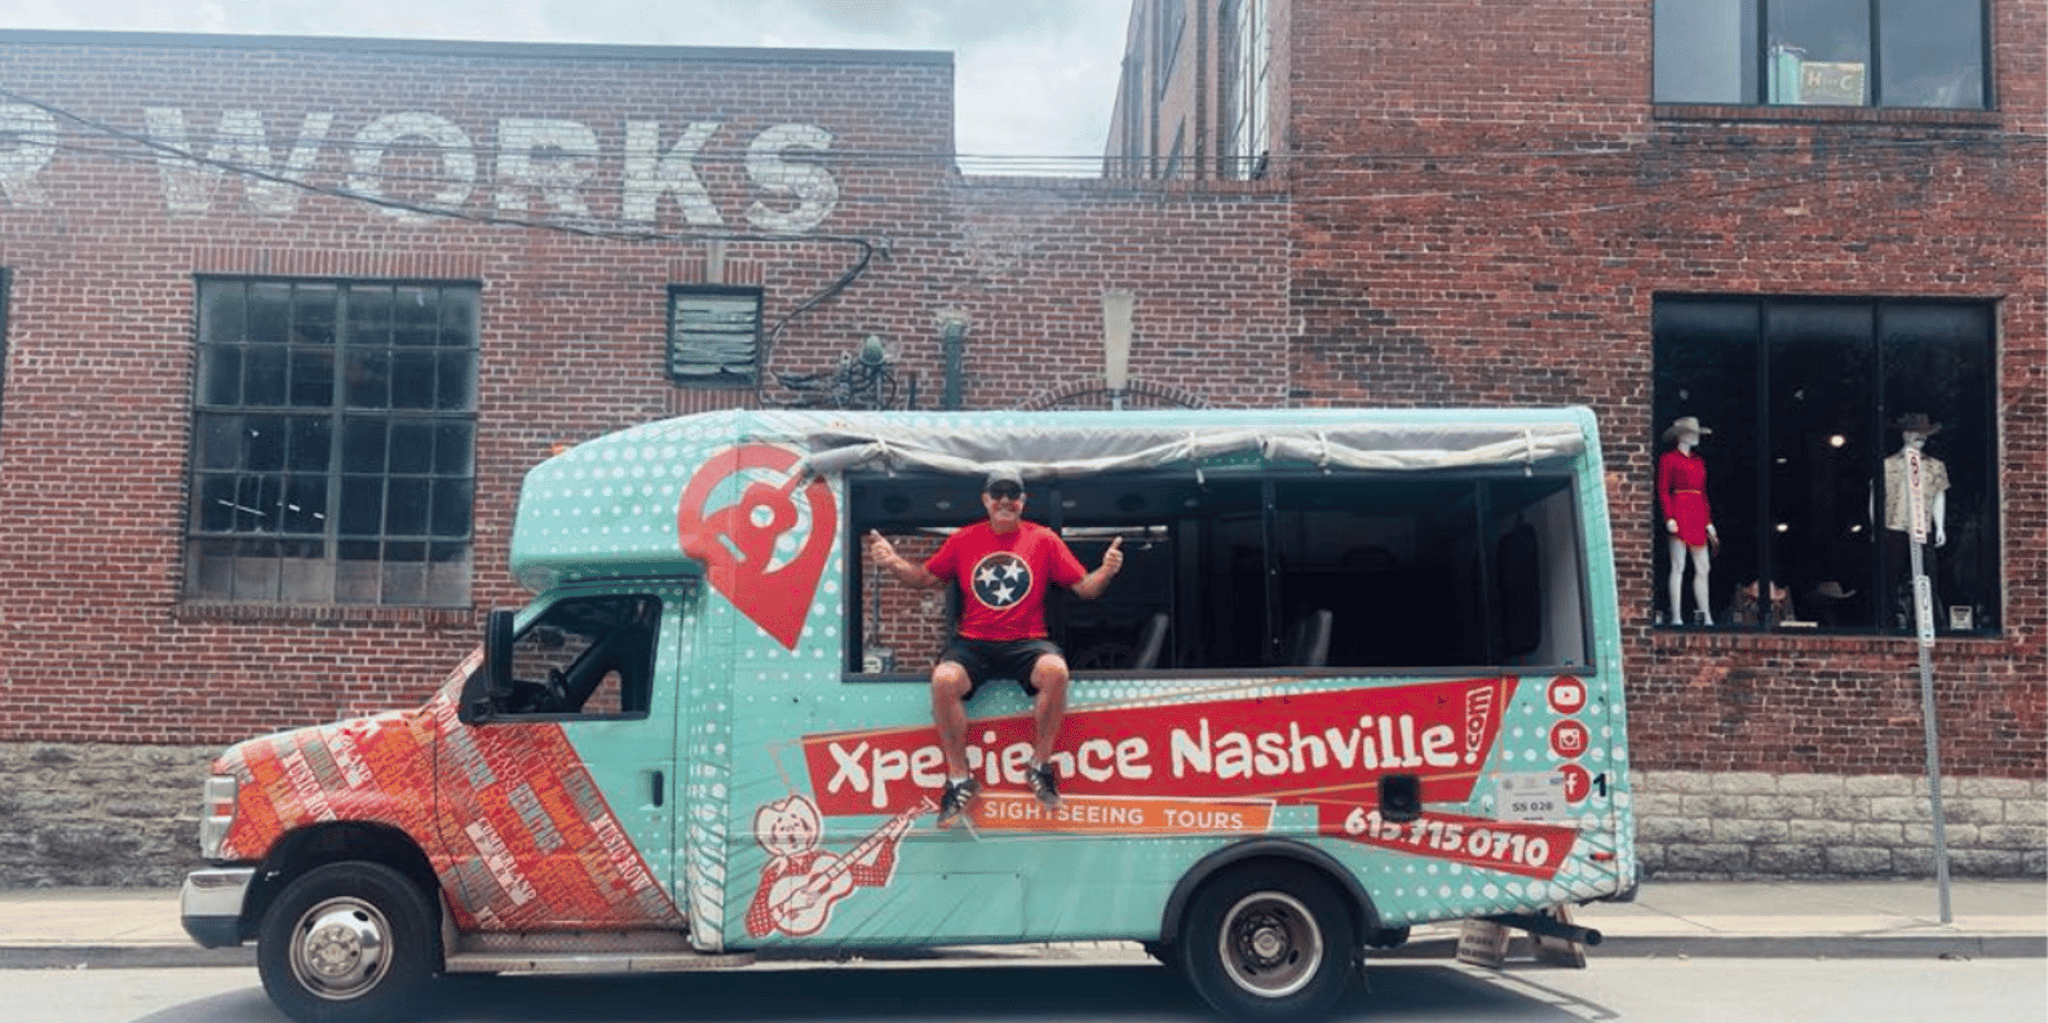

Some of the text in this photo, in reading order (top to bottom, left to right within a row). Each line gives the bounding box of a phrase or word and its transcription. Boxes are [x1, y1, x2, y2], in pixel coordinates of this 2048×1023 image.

[143, 107, 840, 231] WORKS
[279, 748, 322, 797] MUSIC
[1593, 773, 1606, 797] 1
[1163, 808, 1244, 831] TOURS
[1345, 807, 1549, 867] 615.715.0710
[588, 811, 632, 863] MUSIC
[614, 854, 653, 896] ROW
